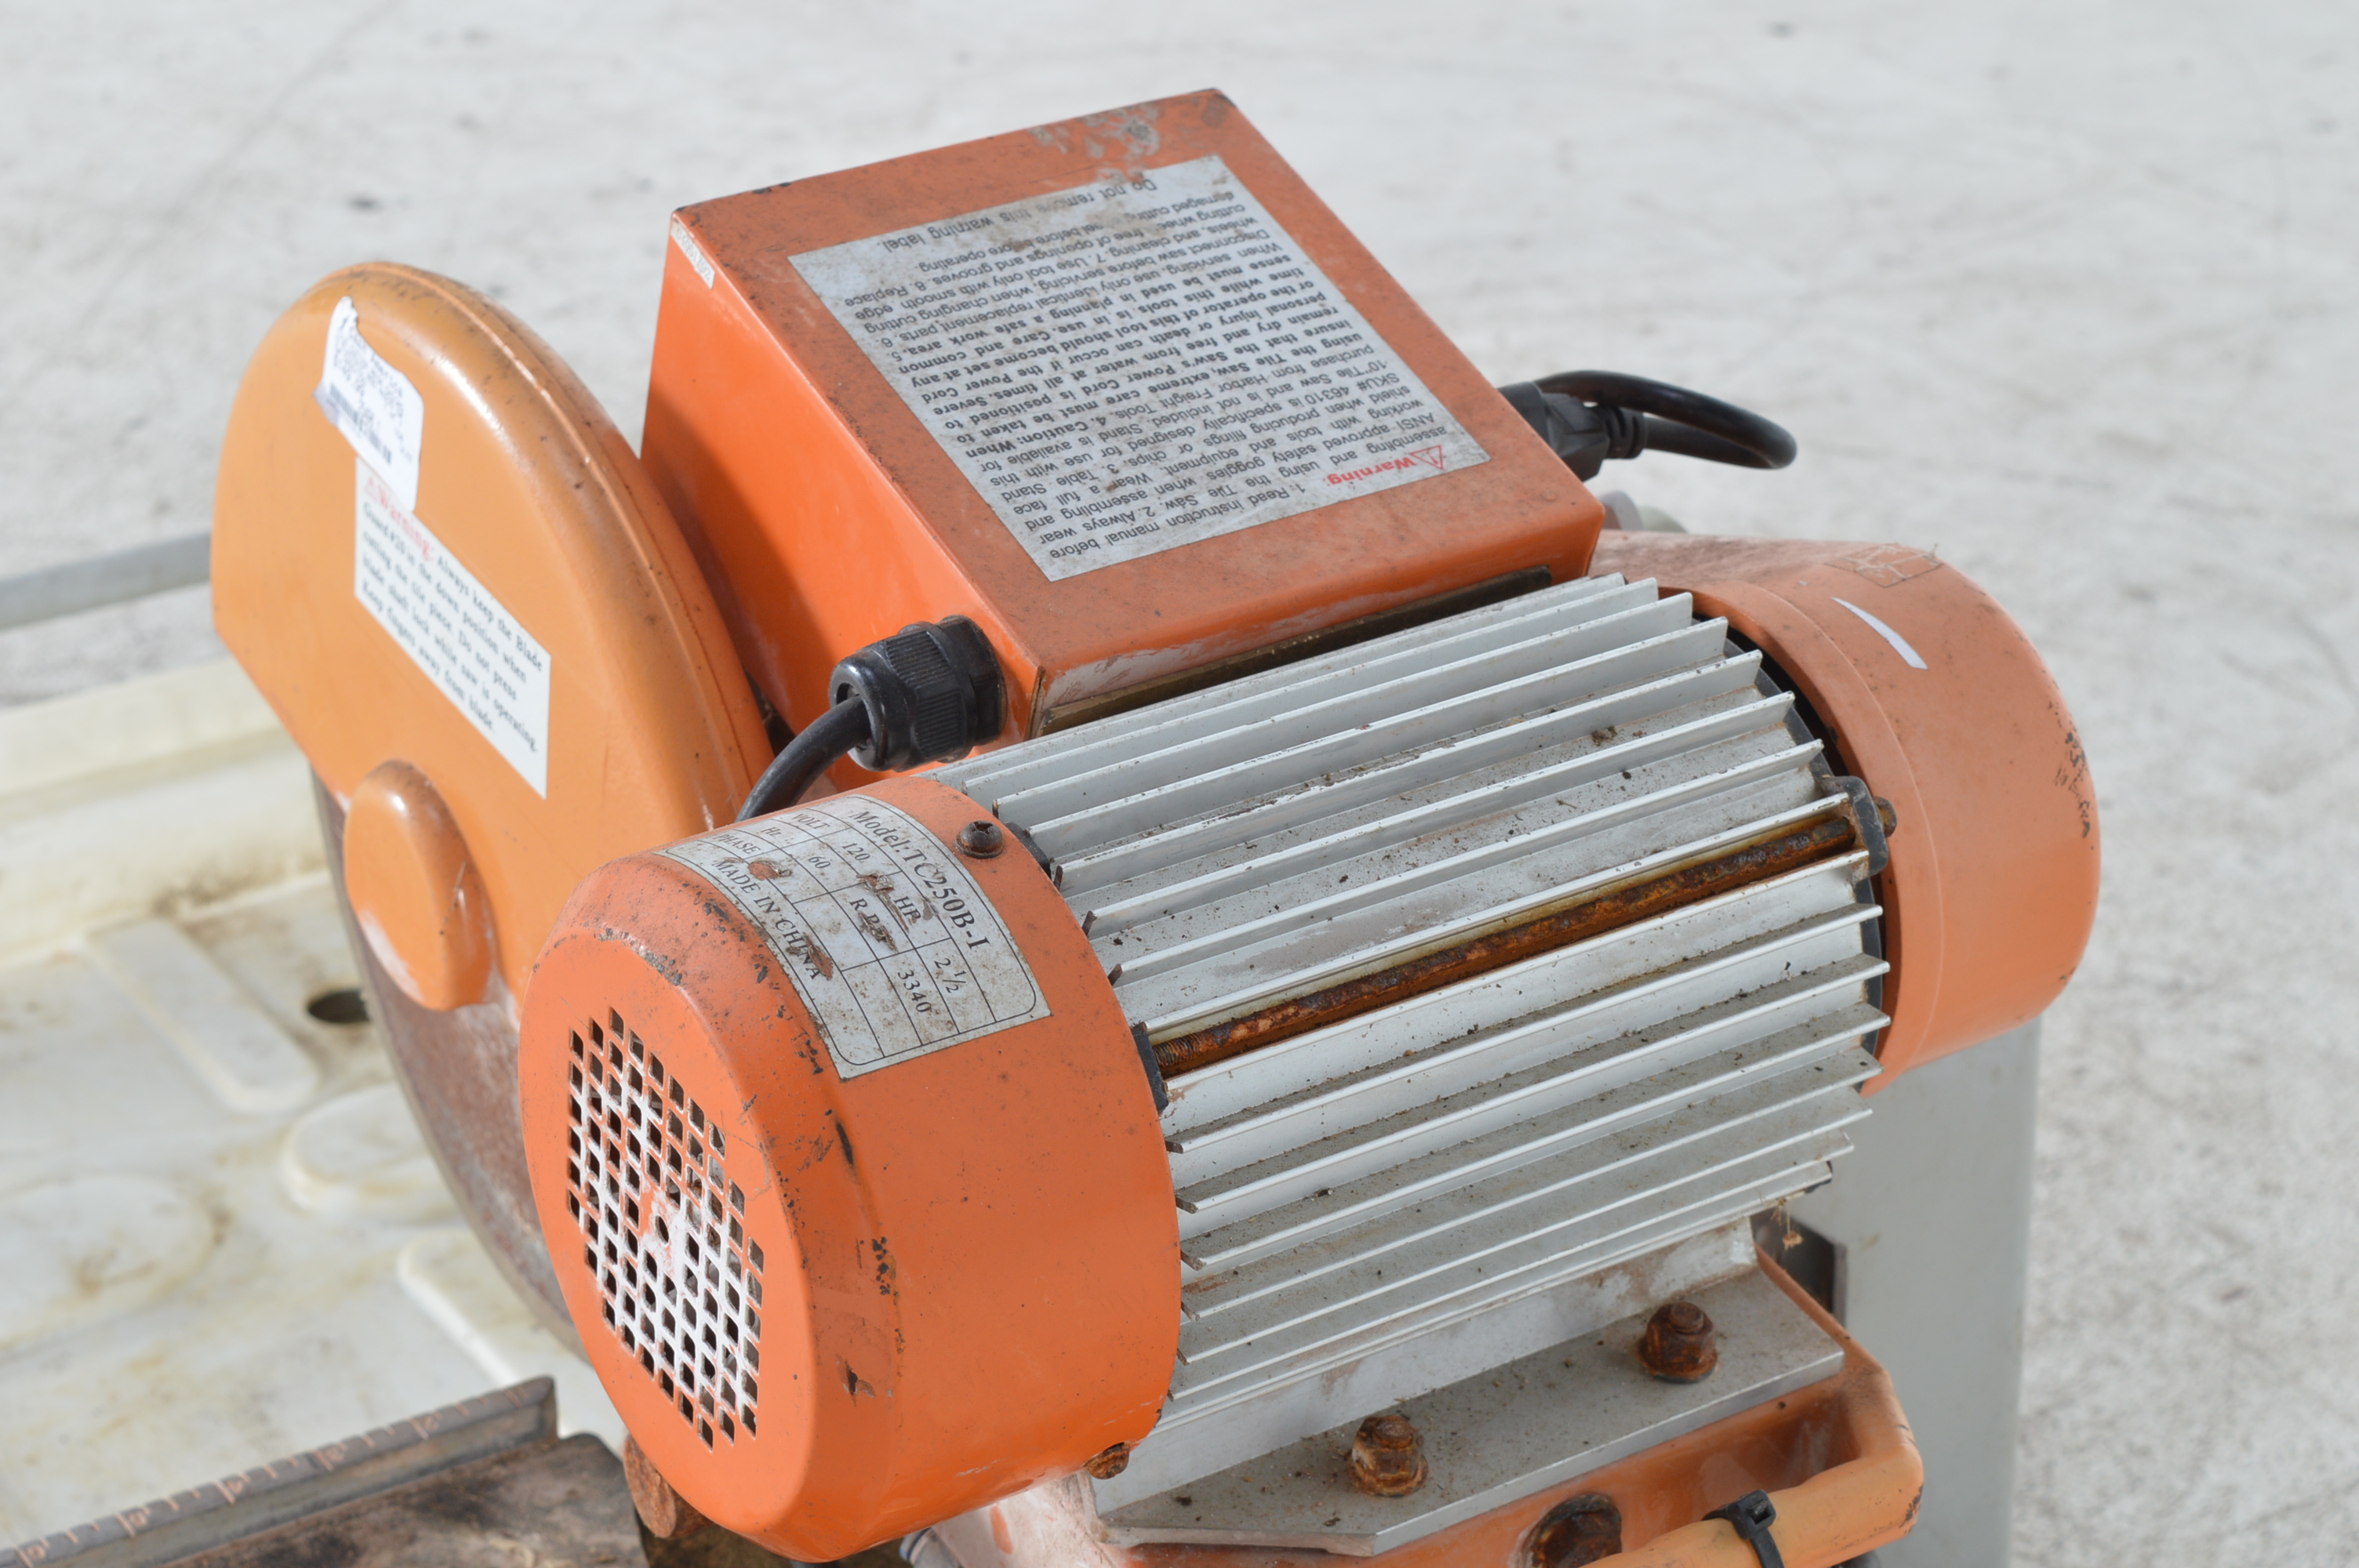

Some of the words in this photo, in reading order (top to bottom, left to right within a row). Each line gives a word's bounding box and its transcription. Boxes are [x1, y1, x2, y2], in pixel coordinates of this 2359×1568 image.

[1098, 185, 1126, 201] not
[926, 216, 994, 242] warning
[876, 233, 926, 253] label.
[1189, 229, 1270, 255] Disconnect
[1237, 242, 1281, 257] When
[1157, 249, 1187, 261] saw
[1161, 252, 1231, 274] servicing,
[1107, 256, 1157, 273] before
[1033, 267, 1105, 292] servicing,
[1100, 277, 1131, 291] only
[1132, 270, 1161, 283] use
[990, 286, 1033, 302] when
[1034, 286, 1099, 309] identical
[917, 296, 988, 320] changing
[1287, 307, 1338, 325] remain
[863, 314, 917, 333] cutting
[940, 302, 1033, 332] replacement
[893, 323, 938, 341] parts.
[1256, 320, 1281, 332] dry
[1303, 319, 1352, 337] insure
[1185, 337, 1218, 350] free
[1222, 328, 1251, 343] and
[1264, 333, 1298, 348] that
[1320, 332, 1362, 348] using
[1141, 347, 1181, 361] from
[1233, 343, 1260, 354] the
[1289, 344, 1317, 357] the
[1310, 344, 1374, 368] purchase
[1094, 358, 1138, 374] water
[1180, 351, 1228, 368] Saw's
[1255, 353, 1287, 365] Tile
[1069, 370, 1088, 382] at
[1126, 365, 1176, 383] Power
[1210, 361, 1250, 376] Saw,
[1271, 364, 1307, 378] from
[1043, 376, 1063, 390] all
[1081, 379, 1120, 396] Cord
[1147, 372, 1210, 394] extreme
[1217, 374, 1268, 393] Harbor
[1356, 372, 1399, 391] SKU#
[988, 383, 1038, 400] times.
[1058, 390, 1077, 400] is
[1104, 390, 1140, 405] care
[1158, 387, 1213, 408] Freight
[1303, 386, 1349, 405] 46310
[1368, 385, 1410, 404] shield
[932, 396, 988, 415] Severe
[969, 394, 1052, 425] positioned
[1059, 401, 1099, 419] must
[1287, 397, 1304, 407] is
[1325, 398, 1364, 413] when
[1367, 399, 1423, 419] working
[1031, 412, 1056, 423] be
[1110, 404, 1157, 419] Tools.
[1202, 402, 1282, 430] specifically
[944, 419, 964, 430] to
[980, 419, 1027, 438] taken
[1249, 408, 1320, 434] producing
[1329, 416, 1361, 430] with
[1395, 412, 1434, 430] ANSI
[955, 433, 976, 445] to
[1016, 421, 1089, 445] Caution:
[1126, 425, 1195, 452] designed
[1202, 429, 1247, 446] filings
[1285, 426, 1323, 441] tools
[1321, 424, 1390, 450] approved
[1365, 426, 1446, 453] assembling
[965, 440, 1016, 458] When
[1100, 445, 1123, 458] for
[1177, 443, 1194, 454] or
[1248, 437, 1277, 454] and
[1271, 444, 1317, 463] safety
[1063, 453, 1093, 466] use
[1122, 450, 1167, 466] chips.
[1159, 448, 1239, 476] equipment.
[1329, 450, 1358, 466] and
[1024, 463, 1059, 477] with
[1101, 463, 1120, 474] 3.
[1205, 456, 1265, 480] goggles
[1278, 460, 1320, 477] using
[1322, 456, 1416, 485] Warning:
[989, 473, 1020, 487] this
[1056, 470, 1099, 486] Table
[1110, 472, 1153, 489] Wear
[1154, 477, 1197, 495] when
[1244, 474, 1272, 487] the
[1001, 483, 1047, 503] Stand
[1088, 485, 1100, 494] a
[1207, 485, 1238, 498] Tile
[1246, 487, 1289, 506] Read
[1012, 500, 1048, 514] face
[1055, 491, 1081, 506] full
[1060, 489, 1147, 519] assembling
[1159, 494, 1198, 510] Saw.
[1081, 510, 1136, 531] Always
[1165, 499, 1244, 526] instruction
[1024, 515, 1056, 532] and
[1039, 528, 1078, 544] wear
[1104, 521, 1160, 546] manual
[1049, 539, 1101, 558] before
[713, 833, 761, 855] PHASE
[791, 813, 831, 829] VOLT
[841, 842, 871, 862] 120
[808, 855, 831, 869] 60
[711, 862, 761, 894] MADE
[753, 895, 780, 913] IN
[894, 895, 921, 920] HP
[897, 969, 932, 1013] 3340
